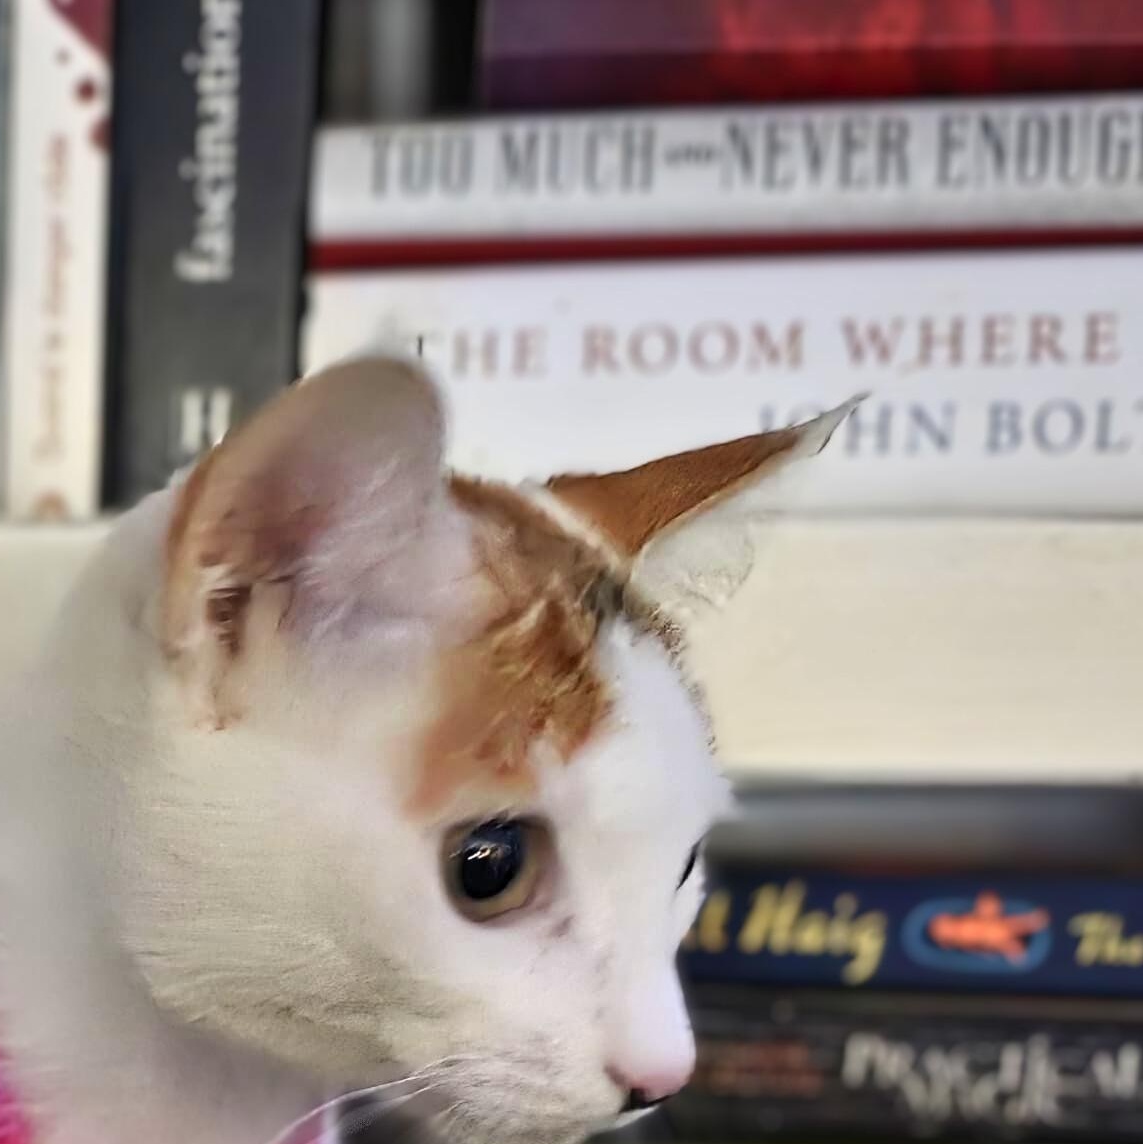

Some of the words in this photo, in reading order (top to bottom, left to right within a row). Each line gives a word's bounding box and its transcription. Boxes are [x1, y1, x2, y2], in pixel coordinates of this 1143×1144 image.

[364, 130, 476, 199] TOO
[494, 120, 658, 197] MUCH
[720, 110, 912, 195] NEVER
[932, 103, 1143, 190] ENOUG
[581, 318, 808, 377] ROOM
[840, 310, 1122, 371] WHERE
[985, 401, 1143, 459] BOL
